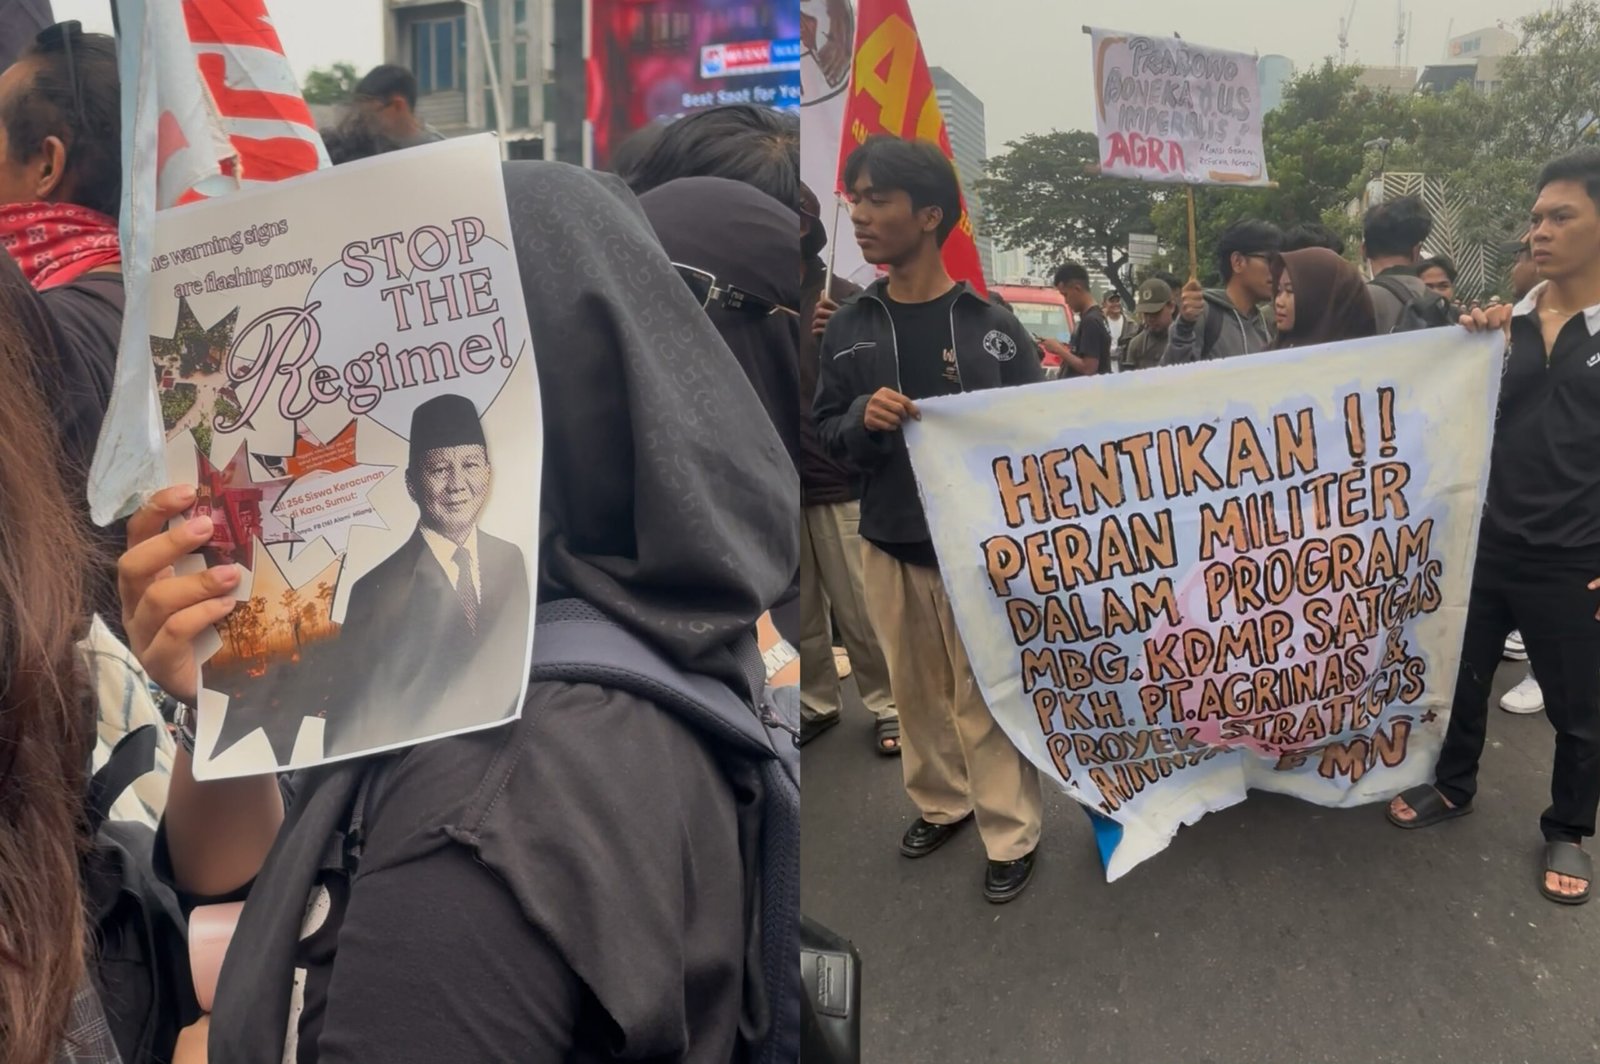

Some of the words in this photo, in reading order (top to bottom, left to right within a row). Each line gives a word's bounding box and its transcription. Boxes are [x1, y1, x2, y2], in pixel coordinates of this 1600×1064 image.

[1104, 131, 1185, 174] AGRA
[169, 231, 244, 265] warning
[244, 219, 288, 248] signs
[341, 216, 485, 287] STOP
[174, 277, 204, 298] are
[204, 258, 275, 293] flashing
[274, 255, 318, 279] now,
[380, 267, 499, 332] THE
[213, 300, 514, 434] Regime!
[287, 494, 304, 508] 256
[304, 487, 333, 502] Siswa
[333, 470, 385, 494] Keracunan
[992, 407, 1319, 528] HENTIKAN
[289, 509, 298, 519] di
[299, 504, 325, 518] Karo,
[980, 508, 1178, 598] PERAN
[1199, 461, 1411, 561] MILITER
[1006, 575, 1180, 645] DALAM
[1203, 518, 1435, 622] PROGRAM
[1046, 724, 1208, 782] PROYEK
[1220, 655, 1426, 746] STRATEGIS
